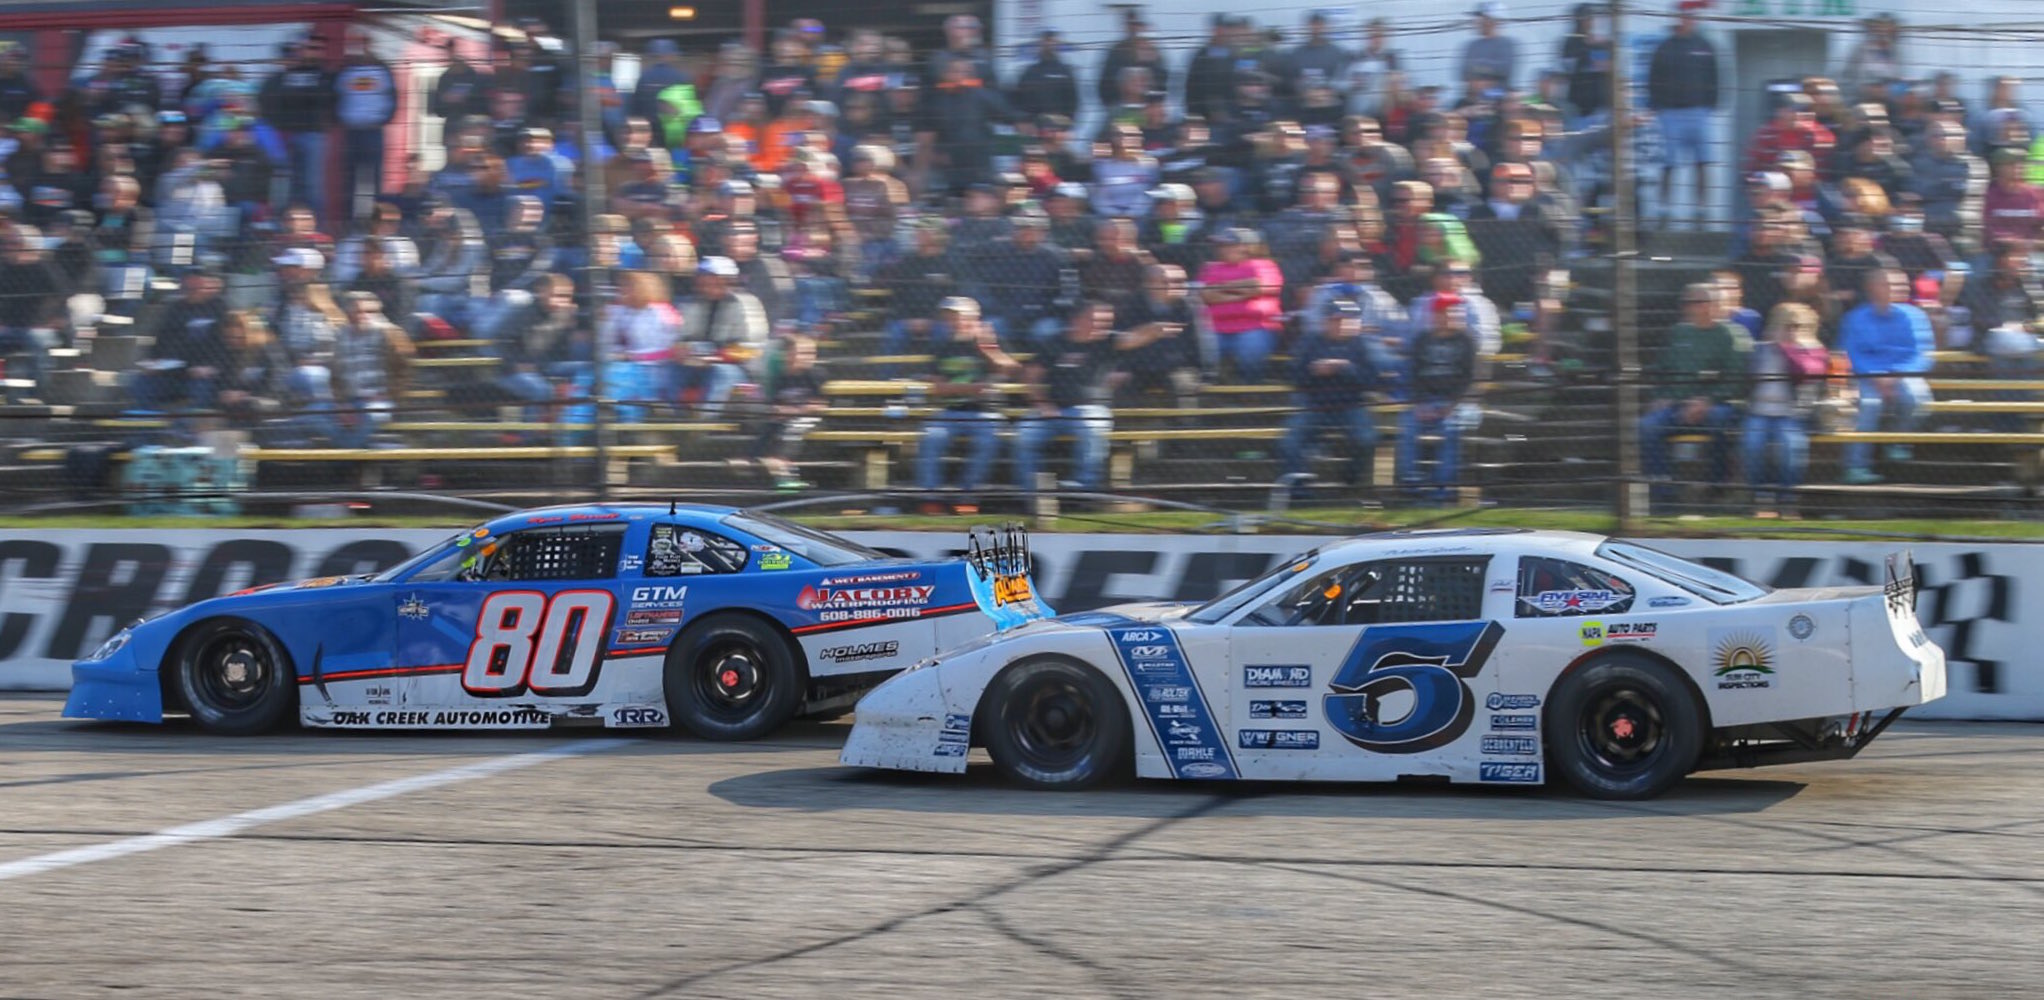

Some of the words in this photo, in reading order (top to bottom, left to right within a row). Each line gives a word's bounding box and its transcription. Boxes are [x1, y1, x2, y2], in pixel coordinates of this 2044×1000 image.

[632, 585, 689, 602] GTM
[817, 585, 935, 602] JACOBY
[1540, 592, 1572, 602] FIVE
[1579, 590, 1611, 600] STAR
[631, 600, 685, 609] SERVICES
[811, 597, 929, 609] WATERPROOFING
[820, 607, 922, 622] 608-886-0016
[1121, 631, 1150, 642] ARCA
[1581, 627, 1602, 639] NAPA
[1607, 623, 1630, 634] AUTO
[1631, 622, 1658, 633] PARTS
[460, 588, 619, 698] 80
[820, 640, 899, 660] HOLMES
[1245, 667, 1309, 681] DIAMND
[1322, 619, 1507, 755] 5
[1717, 680, 1770, 690] INSPECTIONS
[333, 711, 371, 725] OAK
[376, 711, 429, 725] CREEK
[433, 710, 550, 725] AUTOMOTIVE
[1177, 747, 1216, 757] MAHLE
[1481, 764, 1538, 777] TIGER
